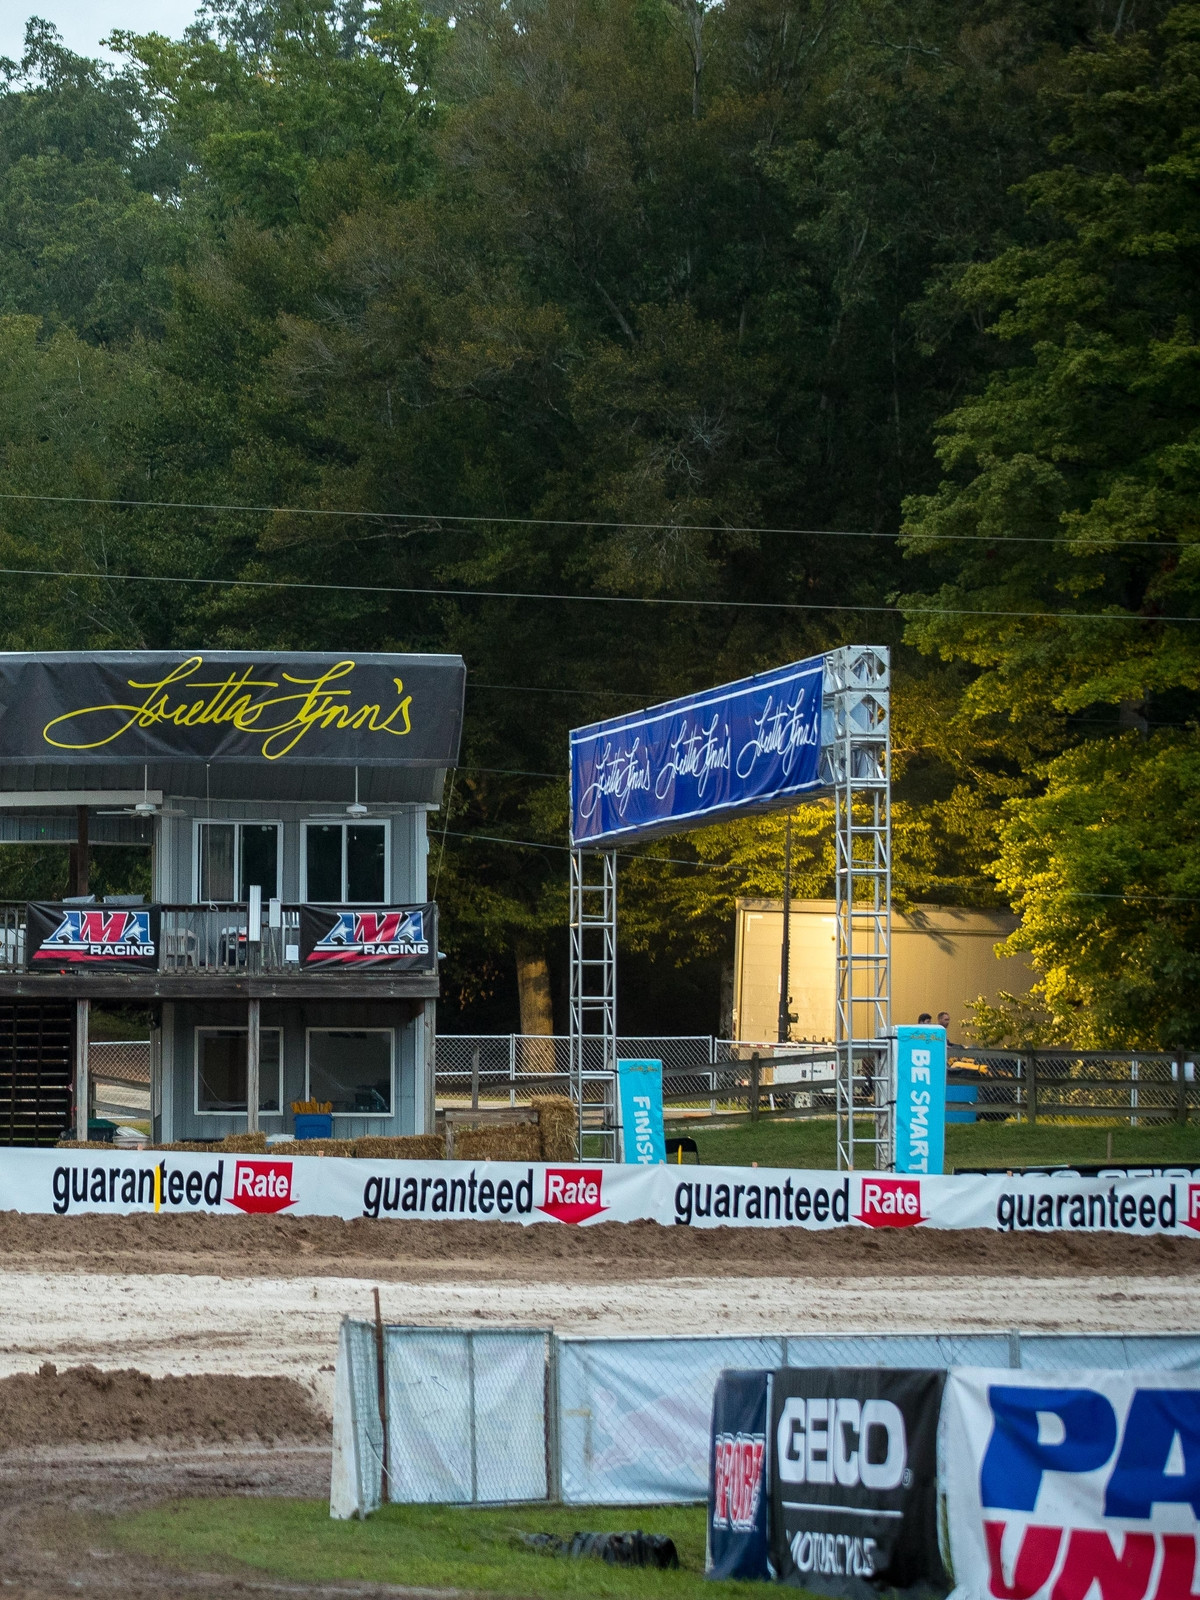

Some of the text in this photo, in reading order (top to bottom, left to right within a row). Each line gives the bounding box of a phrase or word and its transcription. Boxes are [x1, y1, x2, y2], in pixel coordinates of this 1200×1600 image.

[43, 656, 412, 760] Loretta Lynn's
[43, 911, 154, 945] AMA
[90, 945, 155, 956] RACING
[317, 911, 428, 945] AMA
[363, 945, 429, 955] RACING
[911, 1049, 931, 1085] BE
[908, 1090, 931, 1174] SMART
[53, 1160, 290, 1214] guaranteed Rate
[363, 1169, 599, 1218] guaranteed Rate
[676, 1177, 919, 1226] guaranteed Rate
[996, 1184, 1177, 1233] guaranteed
[777, 1397, 907, 1490] GEICO
